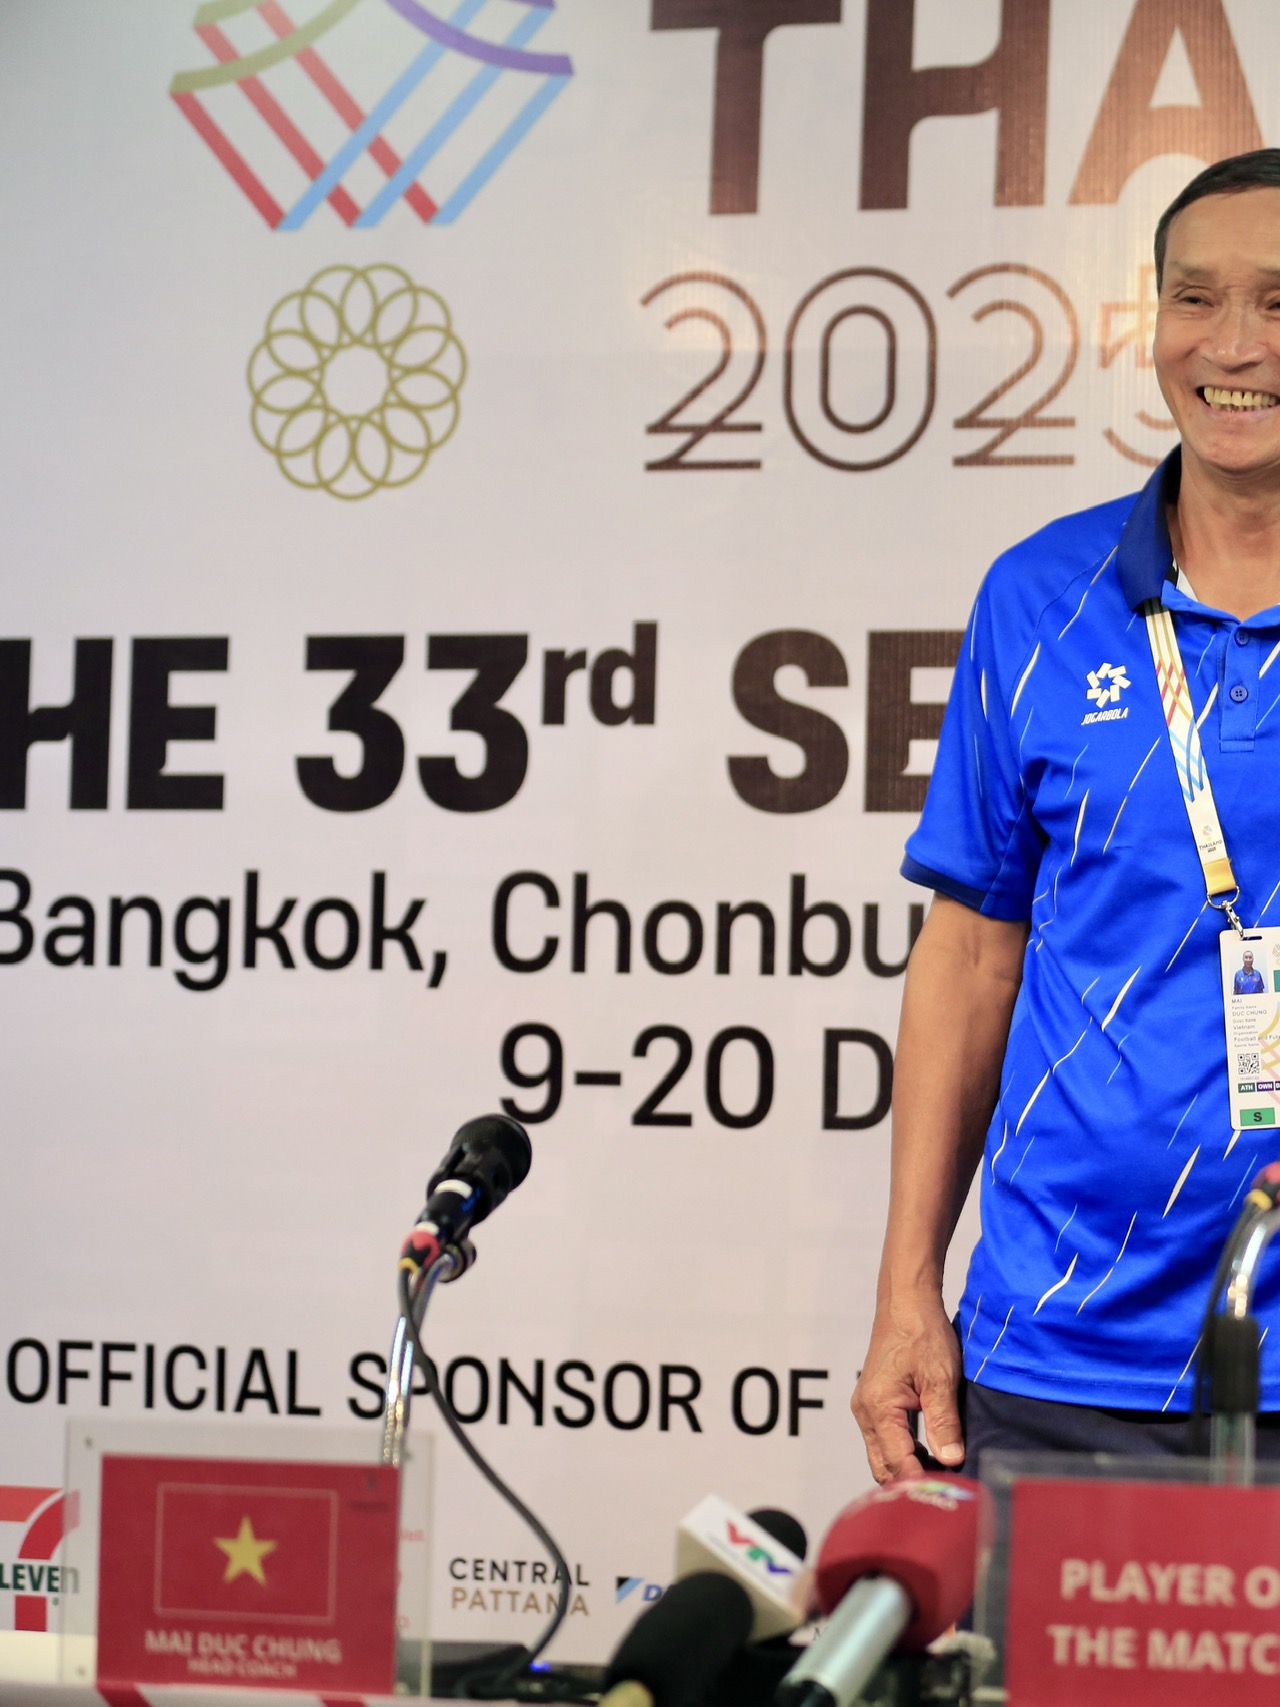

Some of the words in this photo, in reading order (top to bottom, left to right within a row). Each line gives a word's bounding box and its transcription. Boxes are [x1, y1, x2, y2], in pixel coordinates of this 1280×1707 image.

[295, 621, 659, 814] 33rd
[0, 869, 448, 992] Bangkok,
[1253, 1111, 1263, 1123] S
[6, 1337, 322, 1417] OFFICIAL
[731, 1366, 829, 1437] OF
[1059, 1558, 1236, 1606] PLAYER
[145, 1630, 193, 1656] MAI
[197, 1631, 249, 1659] DUC
[252, 1634, 343, 1665] CHUNG
[1046, 1624, 1138, 1669] THE
